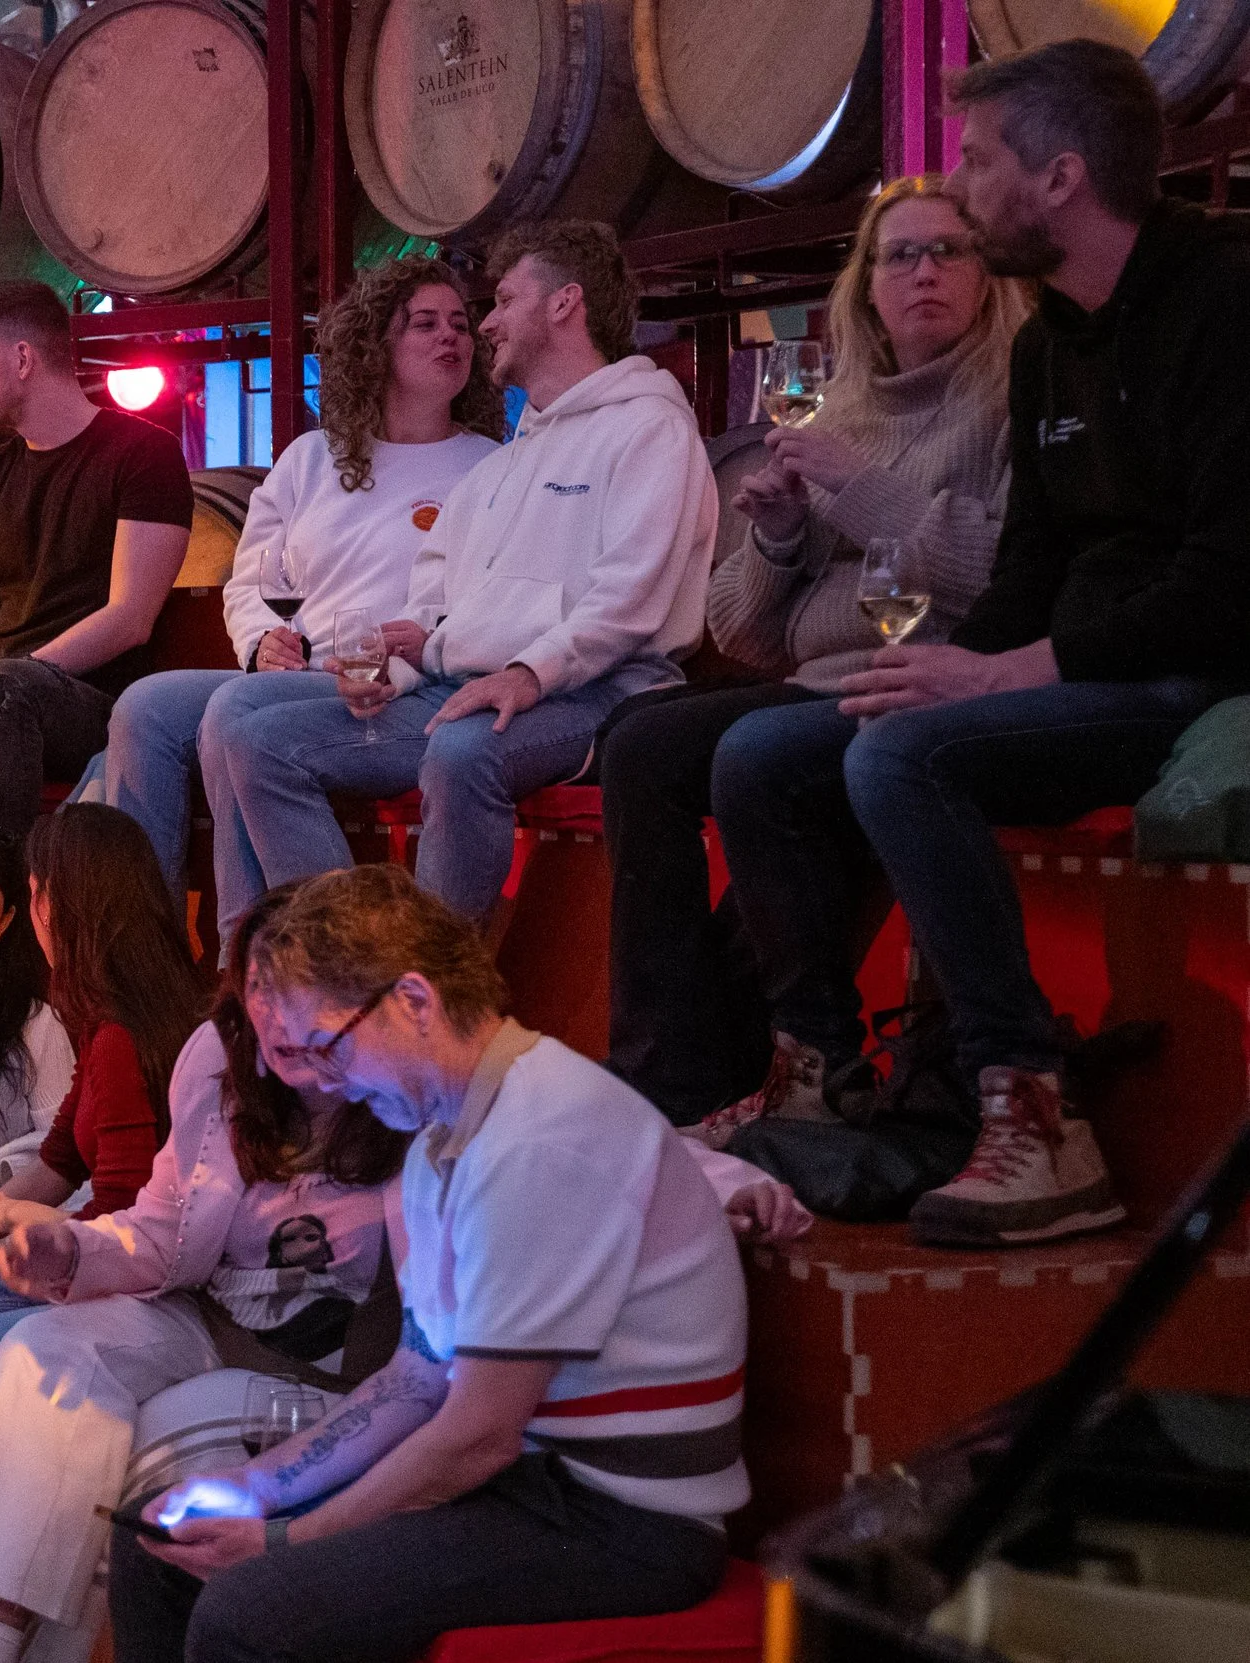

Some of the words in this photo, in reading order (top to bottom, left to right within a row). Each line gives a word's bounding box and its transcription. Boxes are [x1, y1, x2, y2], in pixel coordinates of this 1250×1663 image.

[418, 53, 508, 95] SALENTEIN
[430, 92, 458, 107] VALLE
[460, 86, 472, 99] DE
[475, 82, 495, 96] UCO
